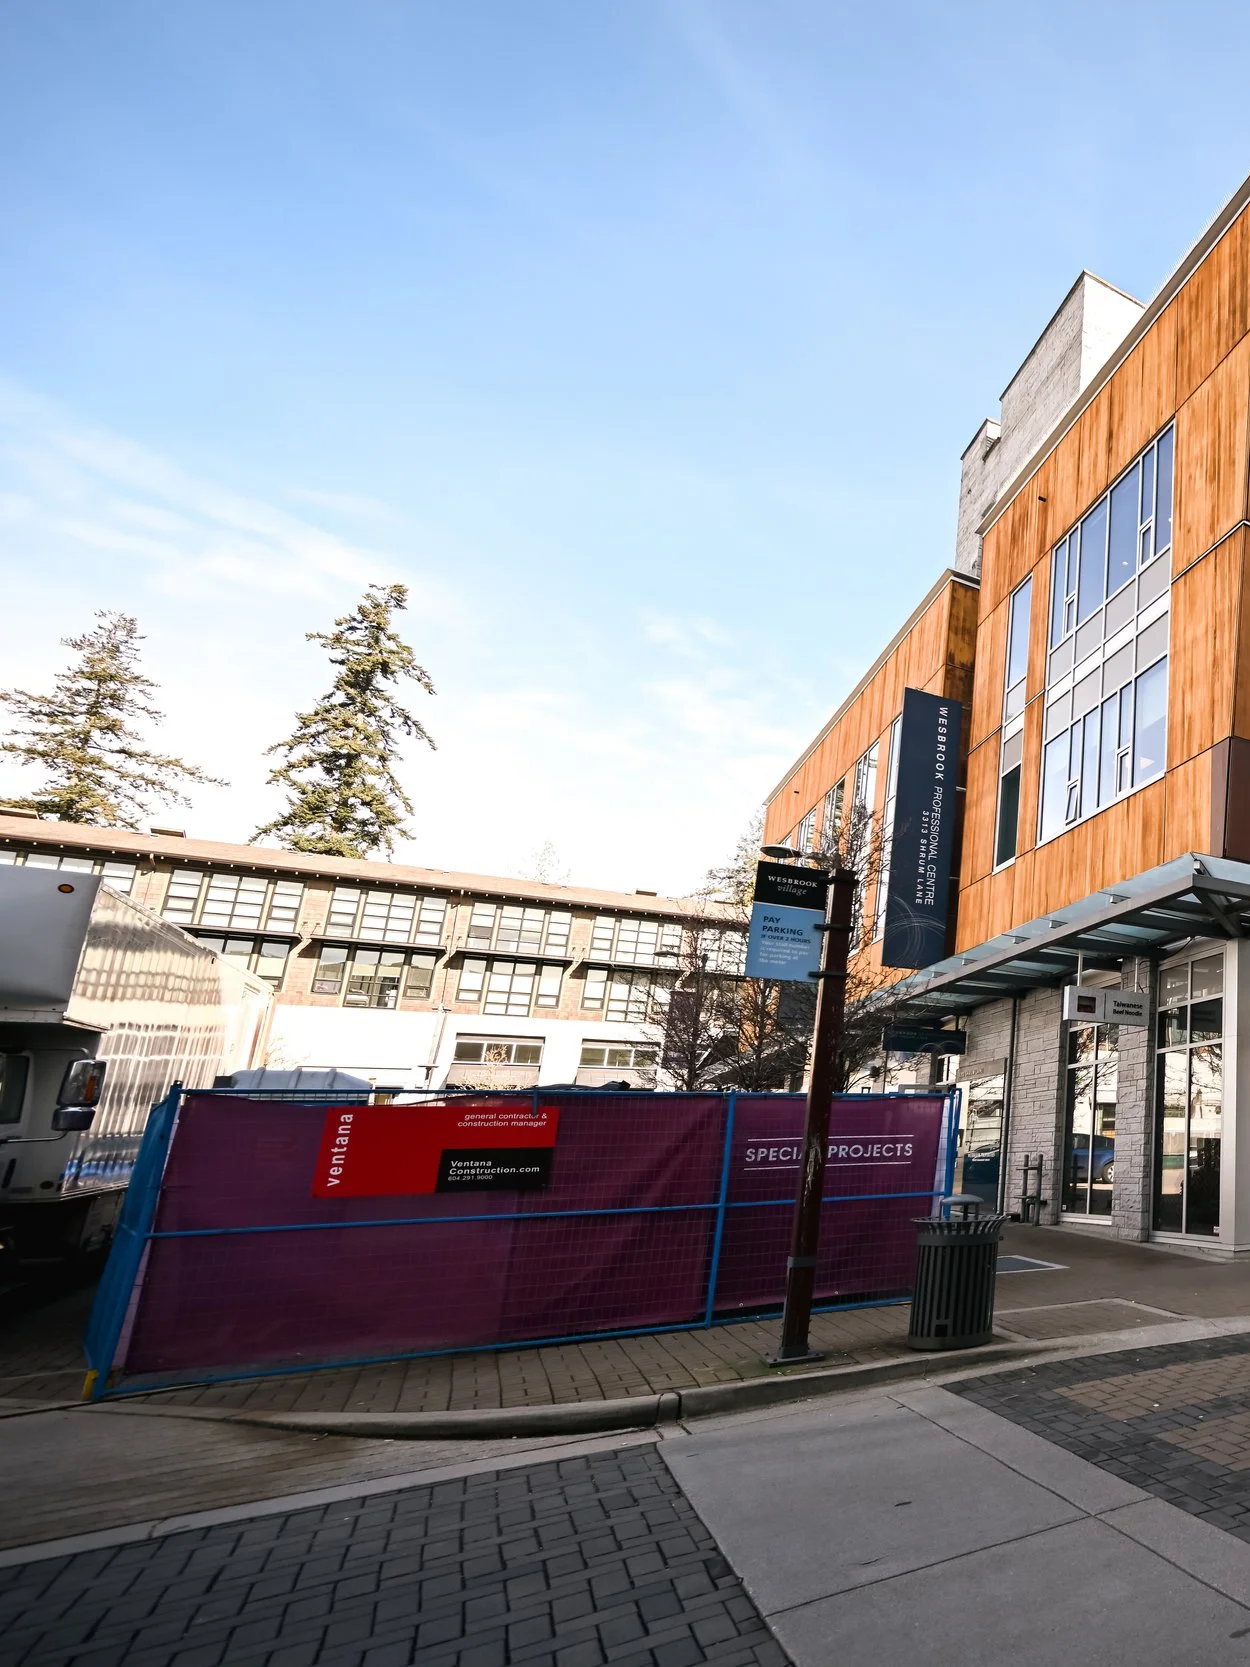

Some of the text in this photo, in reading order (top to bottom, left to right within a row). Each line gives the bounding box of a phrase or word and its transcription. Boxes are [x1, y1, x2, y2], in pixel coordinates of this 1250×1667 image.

[924, 707, 948, 905] WESBROOK PROFESSIONAL CENTRE
[915, 810, 929, 904] 3313 SHRUM LANE
[768, 875, 818, 888] WESBROOK
[777, 884, 807, 896] village
[763, 916, 781, 924] PAY
[762, 925, 804, 936] PARKING
[1112, 1001, 1143, 1009] Taiwanese
[510, 1120, 547, 1128] manager
[326, 1114, 354, 1187] ventana
[745, 1143, 913, 1162] SPECI PROJECTS
[449, 1166, 540, 1175] Construction.com
